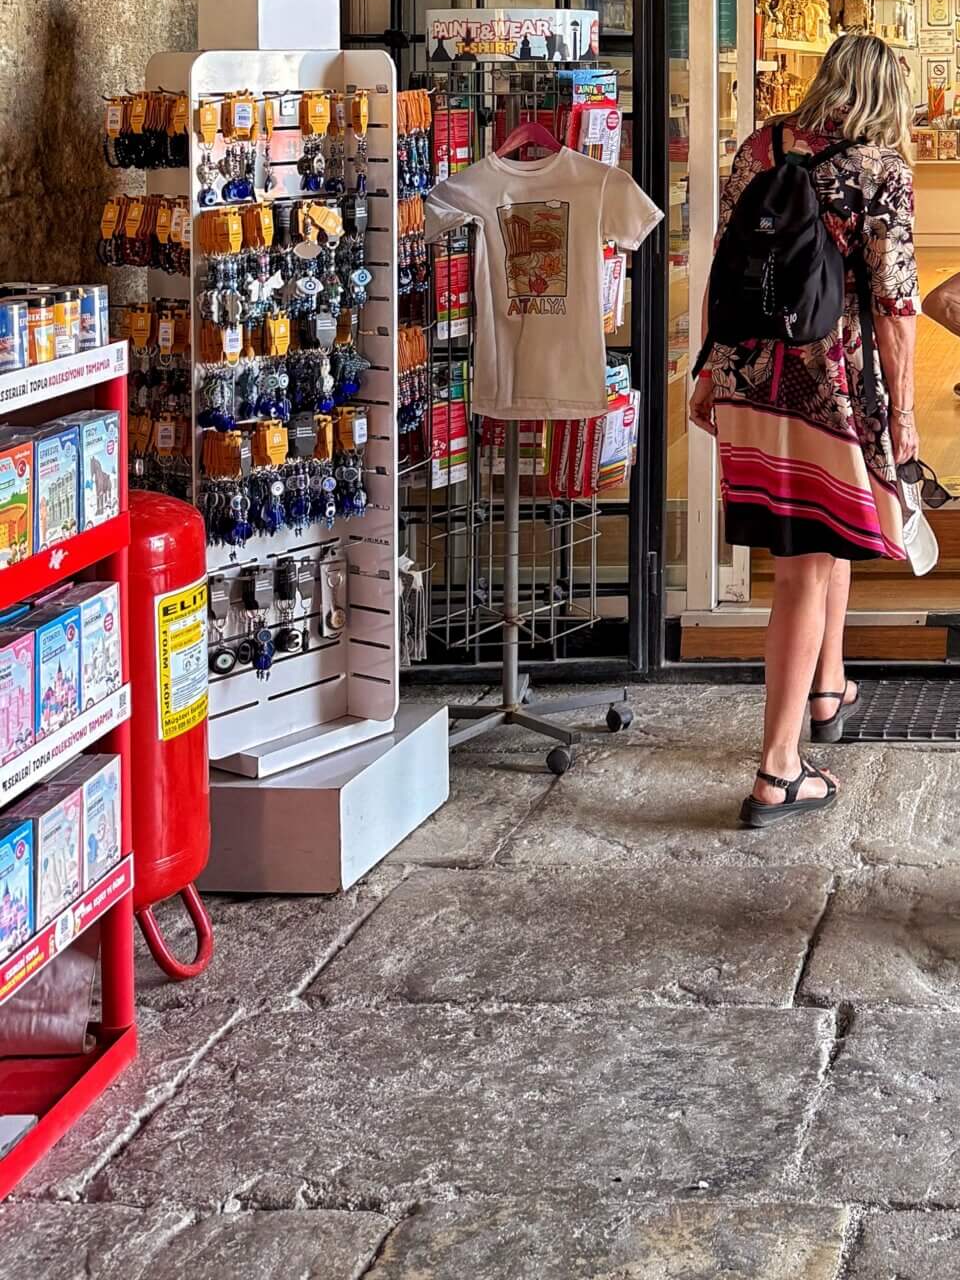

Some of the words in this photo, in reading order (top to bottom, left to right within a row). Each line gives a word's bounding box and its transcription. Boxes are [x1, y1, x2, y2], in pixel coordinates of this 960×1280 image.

[432, 18, 552, 43] PAINT&WEAR
[456, 40, 518, 55] T-SHIRT
[507, 297, 567, 316] ATALYA
